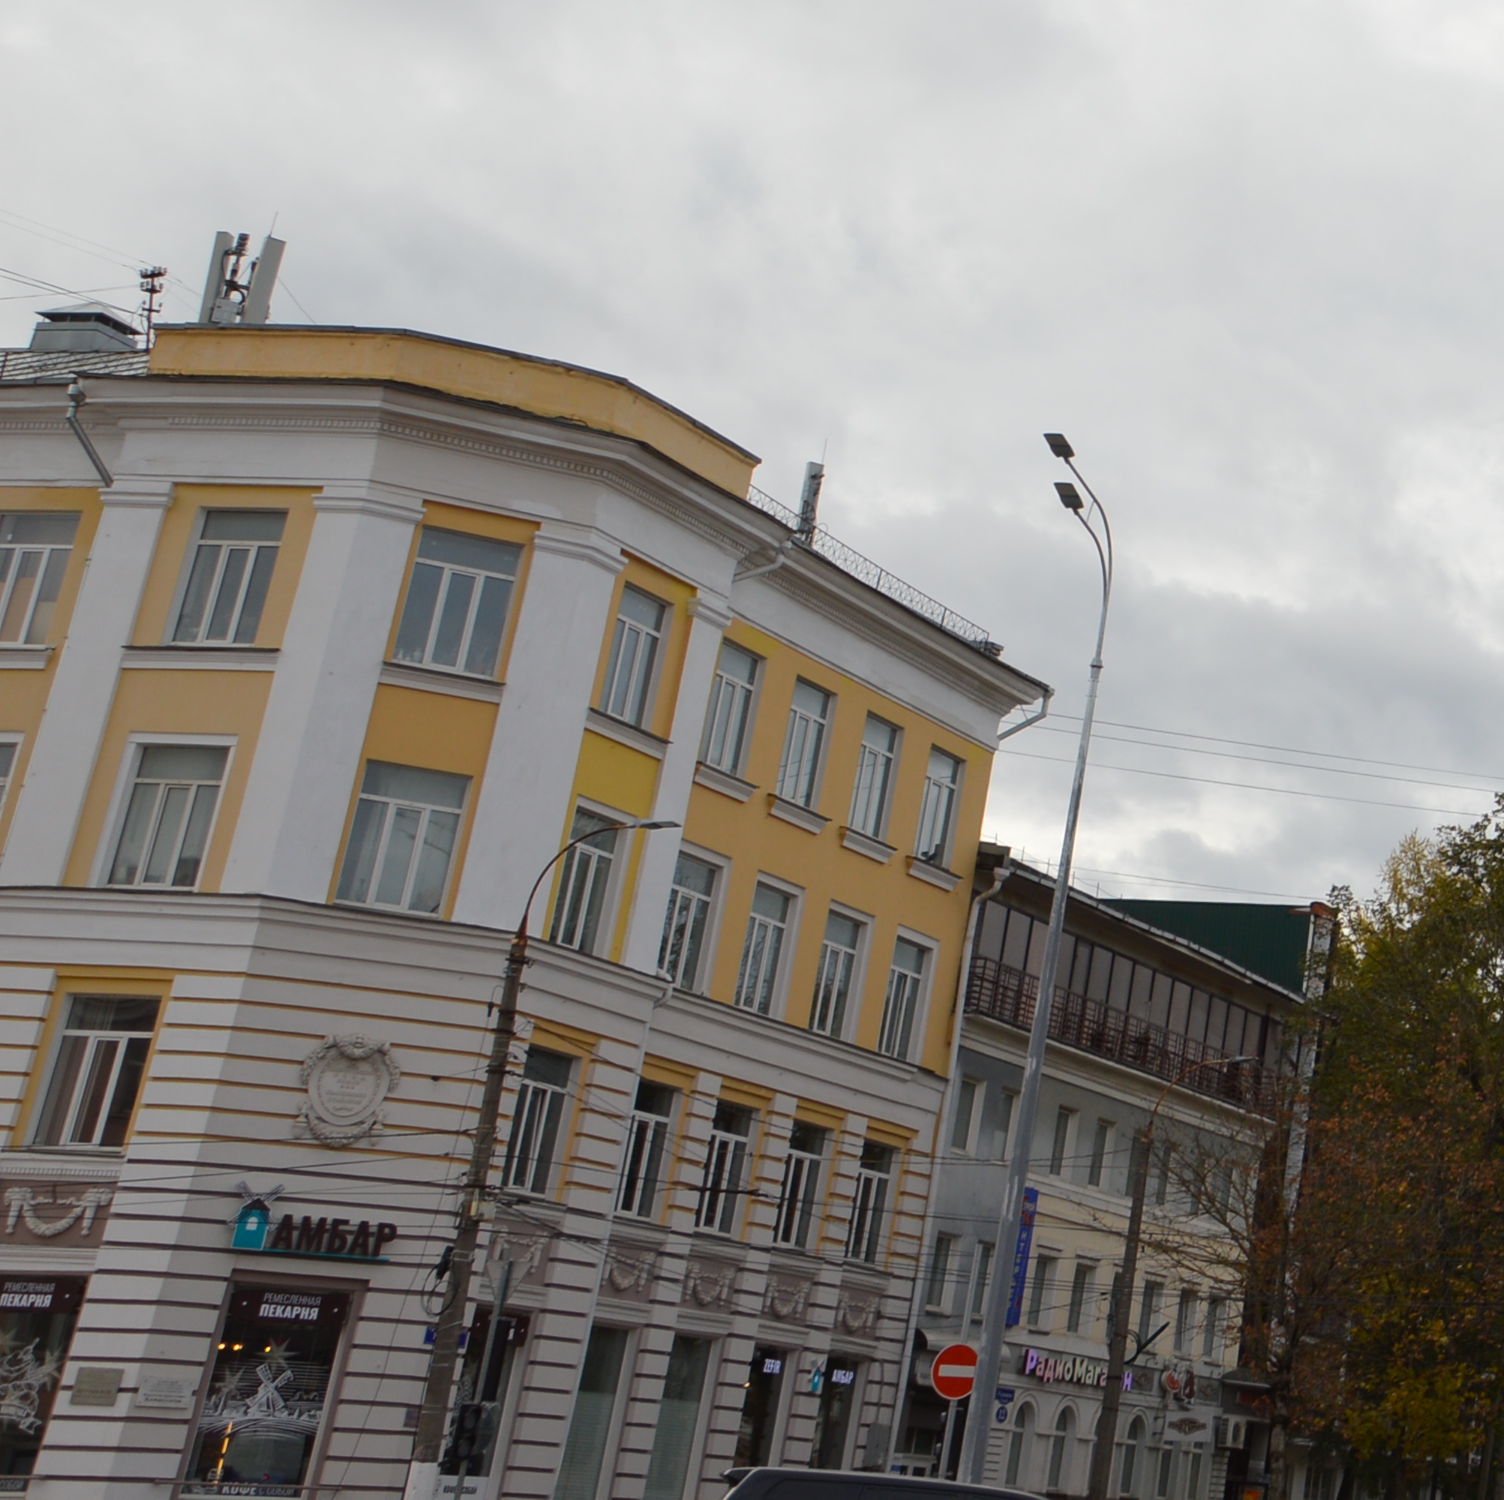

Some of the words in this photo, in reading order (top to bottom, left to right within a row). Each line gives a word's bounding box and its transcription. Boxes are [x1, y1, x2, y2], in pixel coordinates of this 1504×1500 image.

[270, 1214, 397, 1257] АМБАР
[0, 1293, 53, 1308] ПЕКАРНЯ
[263, 1292, 322, 1306] РЕМЕСЛЕННАЯ
[259, 1303, 320, 1321] ПЕКАРНЯ
